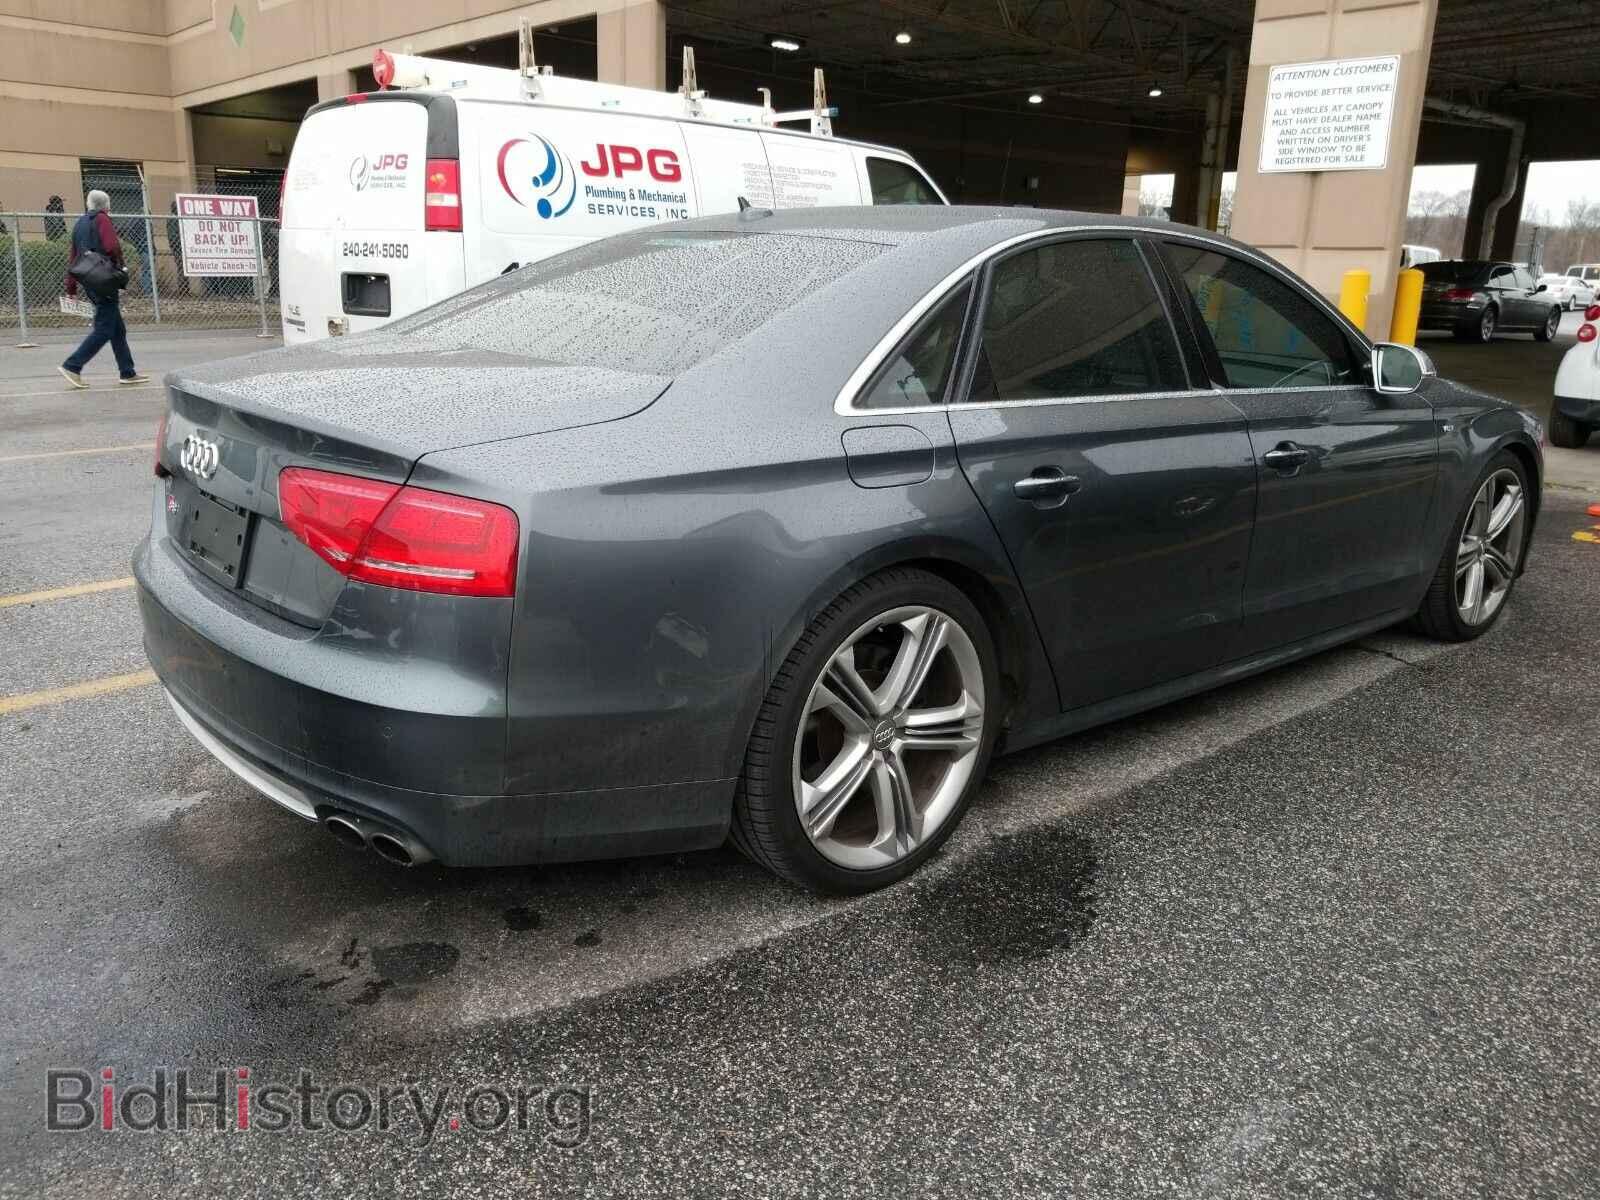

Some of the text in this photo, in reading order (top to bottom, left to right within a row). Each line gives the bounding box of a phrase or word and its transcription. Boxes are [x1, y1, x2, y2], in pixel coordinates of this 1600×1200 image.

[1274, 63, 1394, 81] ATTENTION CUSTOMERS
[1271, 92, 1282, 100] TO
[1284, 89, 1317, 99] PROVIDE
[1321, 87, 1352, 96] BETTER
[1274, 102, 1383, 116] ALL VEHICLES AT CANOPY
[1272, 112, 1383, 127] MUST HAVE DEALER NAME
[1280, 124, 1370, 136] AND ACCESS NUMBER
[1277, 137, 1314, 146] WRITTEN
[1318, 136, 1330, 144] ON
[1278, 144, 1366, 155] SIDE WINDOW TO BE
[372, 153, 409, 171] JPG
[579, 143, 682, 183] JPG
[1275, 154, 1365, 165] REGISTERED FOR SALE
[585, 185, 687, 204] Plumbing & Mechanical
[183, 199, 251, 217] ONE WAY
[587, 203, 660, 220] SERVICES,
[199, 221, 241, 233] DO NOT
[194, 233, 249, 246] BACK UP!
[191, 261, 219, 270] Vehicle
